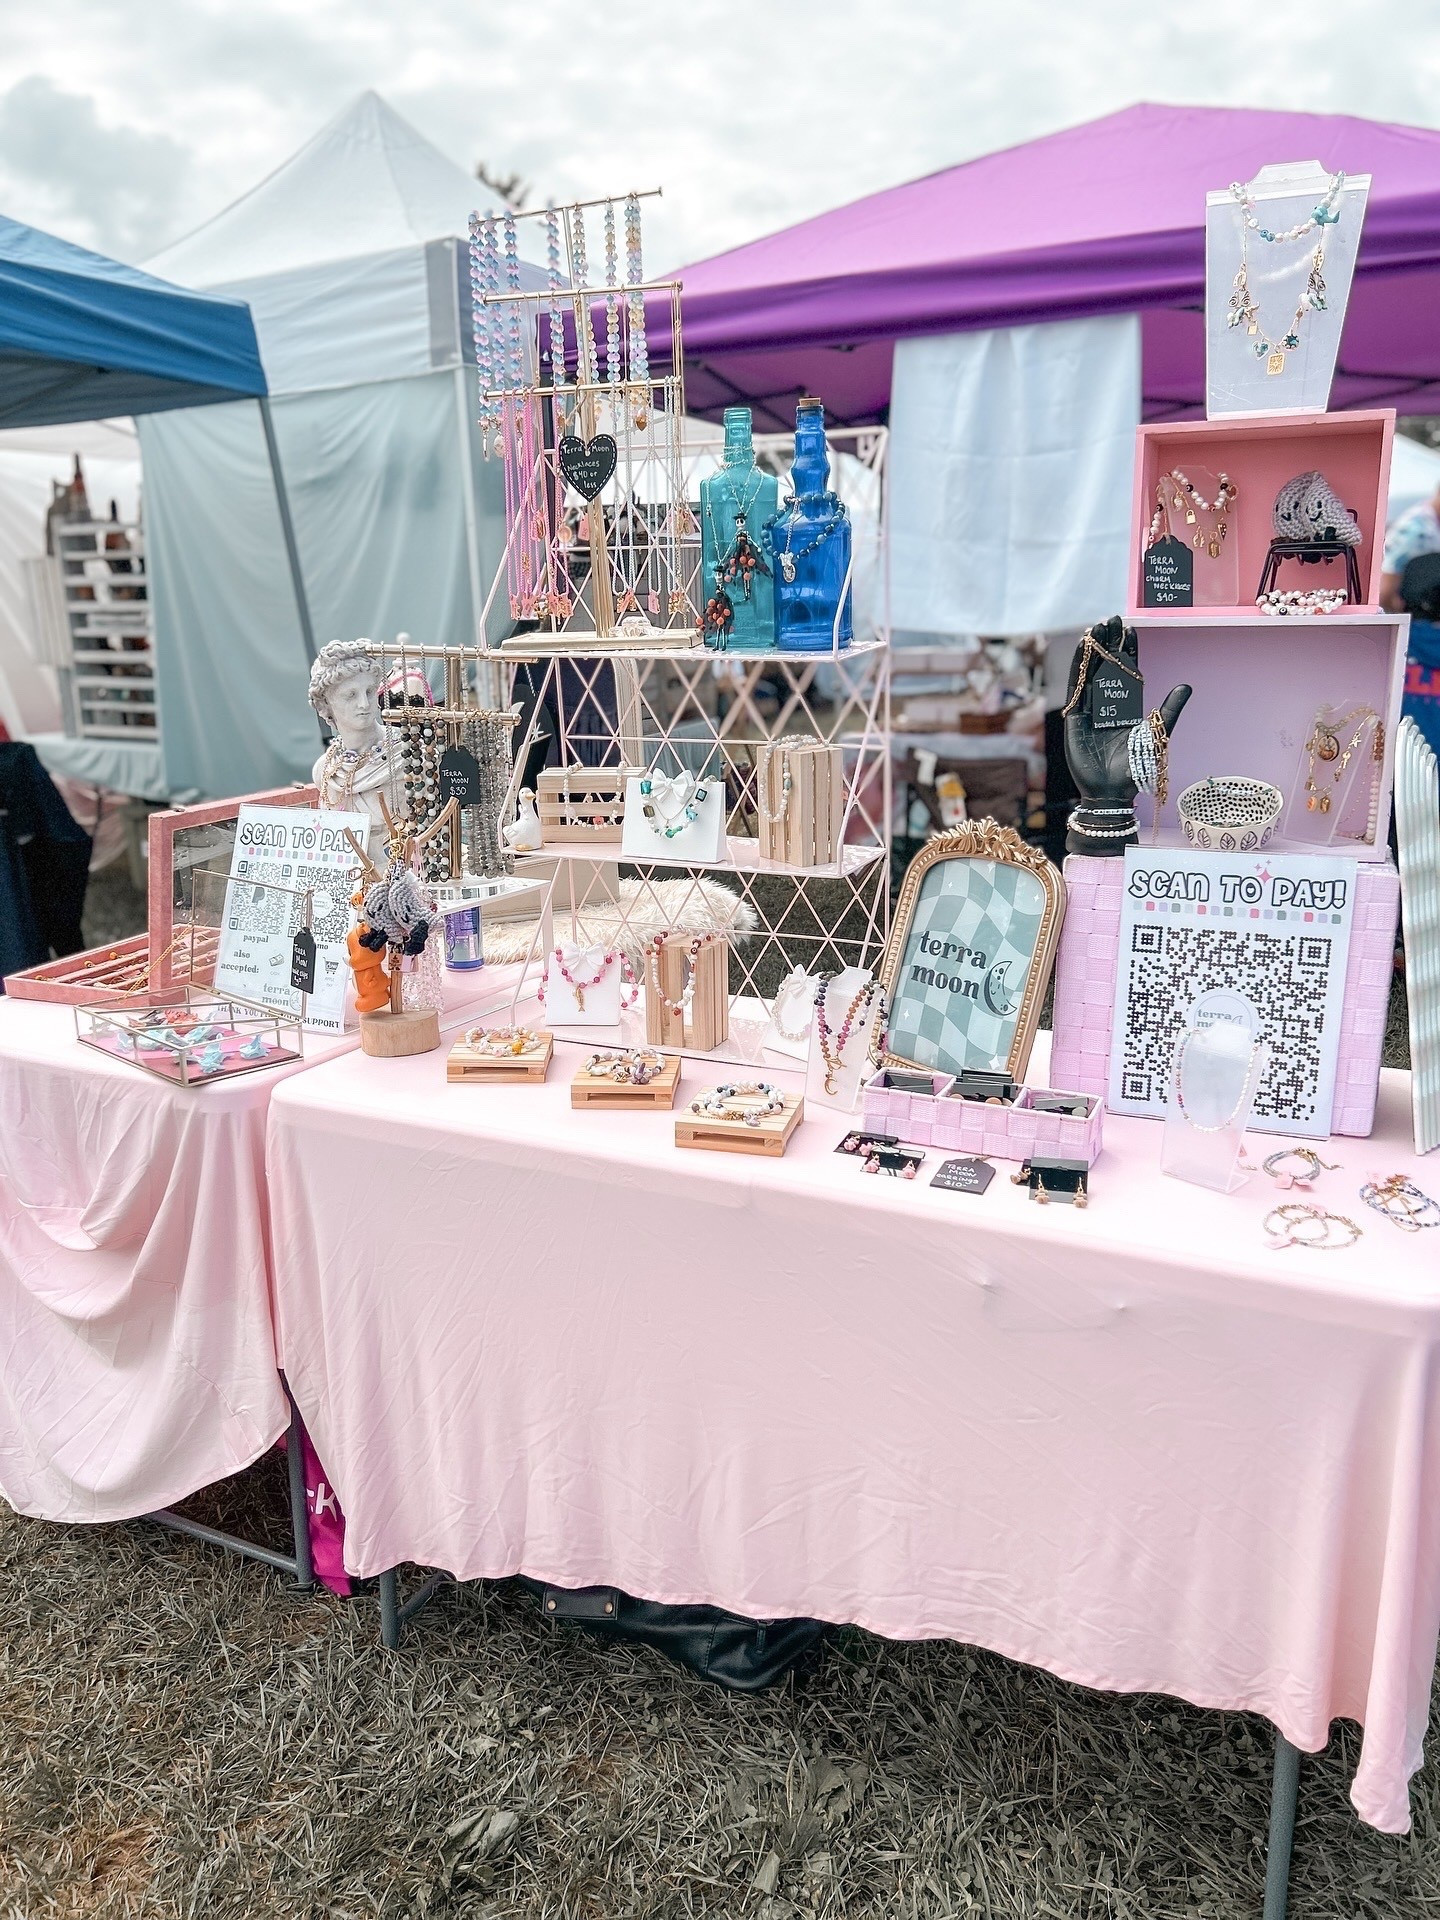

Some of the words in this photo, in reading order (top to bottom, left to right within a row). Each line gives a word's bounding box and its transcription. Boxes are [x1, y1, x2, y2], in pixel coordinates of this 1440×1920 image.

[562, 445, 583, 454] Terra
[573, 471, 588, 480] $40
[1099, 705, 1118, 717] $15
[450, 786, 467, 796] $30
[240, 823, 287, 848] SCAN
[292, 827, 317, 849] TO
[1128, 869, 1210, 902] SCAN
[1220, 875, 1262, 904] TO
[1272, 877, 1347, 910] PAY!
[243, 934, 269, 943] paypal
[233, 950, 251, 959] also
[919, 930, 987, 970] terra
[221, 962, 260, 973] accepted:
[911, 965, 980, 1000] moon
[263, 983, 291, 995] terra
[261, 996, 289, 1006] moon
[1197, 1009, 1232, 1020] terra
[302, 1017, 340, 1029] SUPPORT
